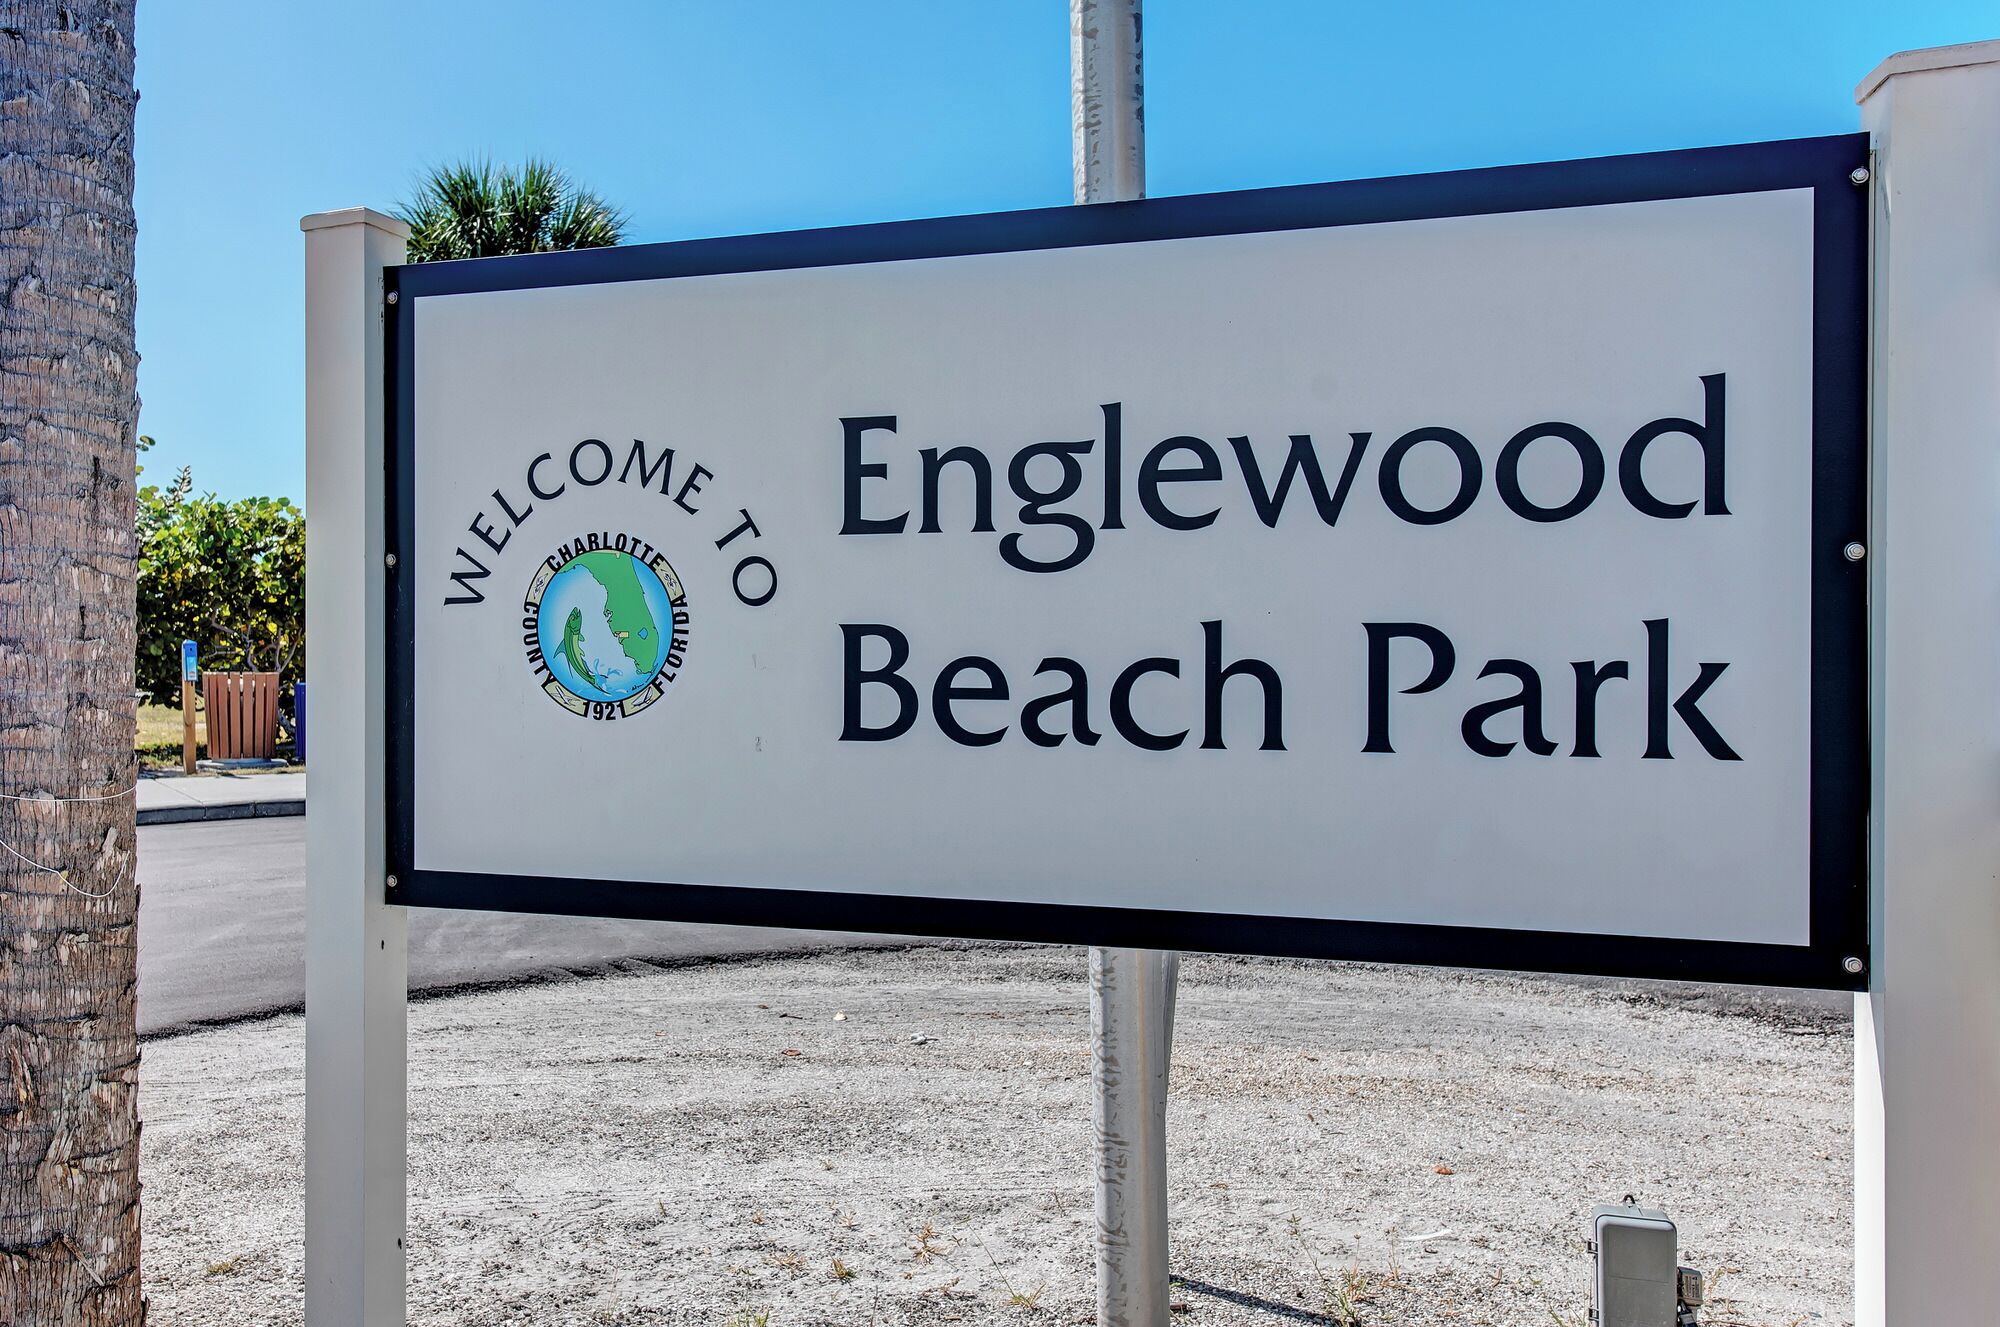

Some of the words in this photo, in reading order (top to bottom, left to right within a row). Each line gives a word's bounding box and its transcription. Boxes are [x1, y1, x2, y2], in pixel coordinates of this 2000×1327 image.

[443, 438, 714, 607] WELCOME
[714, 508, 778, 607] TO
[837, 372, 1733, 573] Englewood
[546, 531, 665, 573] CHARLOTTE
[522, 601, 556, 689] COUNTY
[652, 594, 690, 696] FLORIDA
[837, 619, 1289, 752] Beach
[1360, 617, 1745, 762] Park
[582, 699, 628, 721] 1921
